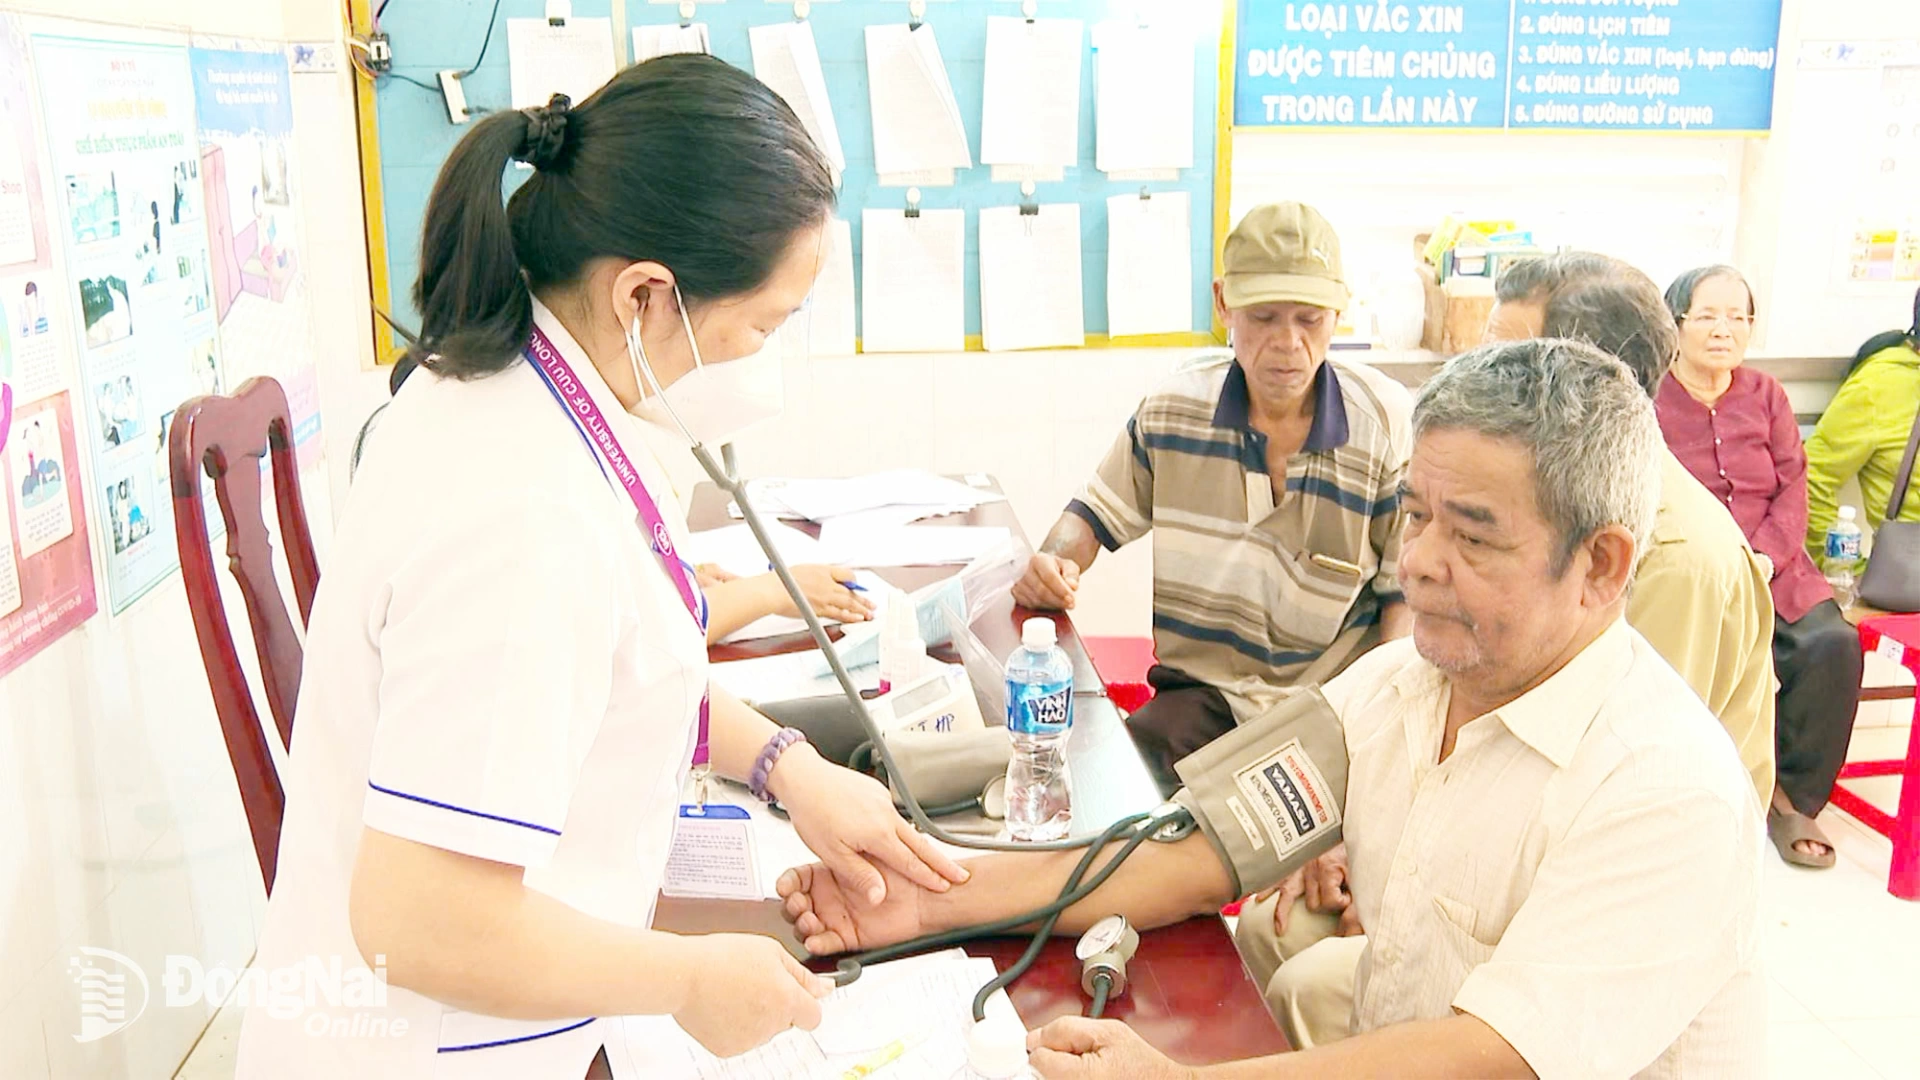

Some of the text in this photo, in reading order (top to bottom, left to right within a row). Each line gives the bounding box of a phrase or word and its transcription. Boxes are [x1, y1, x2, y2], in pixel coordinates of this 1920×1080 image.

[1285, 3, 1347, 39] LOẠI
[1416, 6, 1463, 33] XIN
[1519, 11, 1670, 39] 2. ĐÚNG LỊCH TIÊM
[1248, 41, 1496, 84] ĐƯỢC TIÊM CHỦNG
[1518, 45, 1533, 64] 3.
[1536, 41, 1583, 64] ĐÚNG
[1623, 46, 1652, 65] XIN
[1697, 47, 1726, 70] hạn
[1516, 75, 1531, 93] 4.
[1535, 70, 1580, 94] ĐÚNG
[1625, 73, 1680, 100] LƯỢNG
[1262, 95, 1354, 123] TRONG
[1422, 89, 1478, 123] NÀY
[1533, 99, 1579, 123] ĐÚNG
[1582, 101, 1639, 124] ĐƯỜNG
[1642, 99, 1667, 124] SỬ
[1668, 105, 1713, 129] DỤNG
[552, 366, 578, 396] CUU
[572, 396, 592, 416] OF
[586, 414, 637, 488] UNIVERSITY
[1271, 767, 1310, 830] YAMASU
